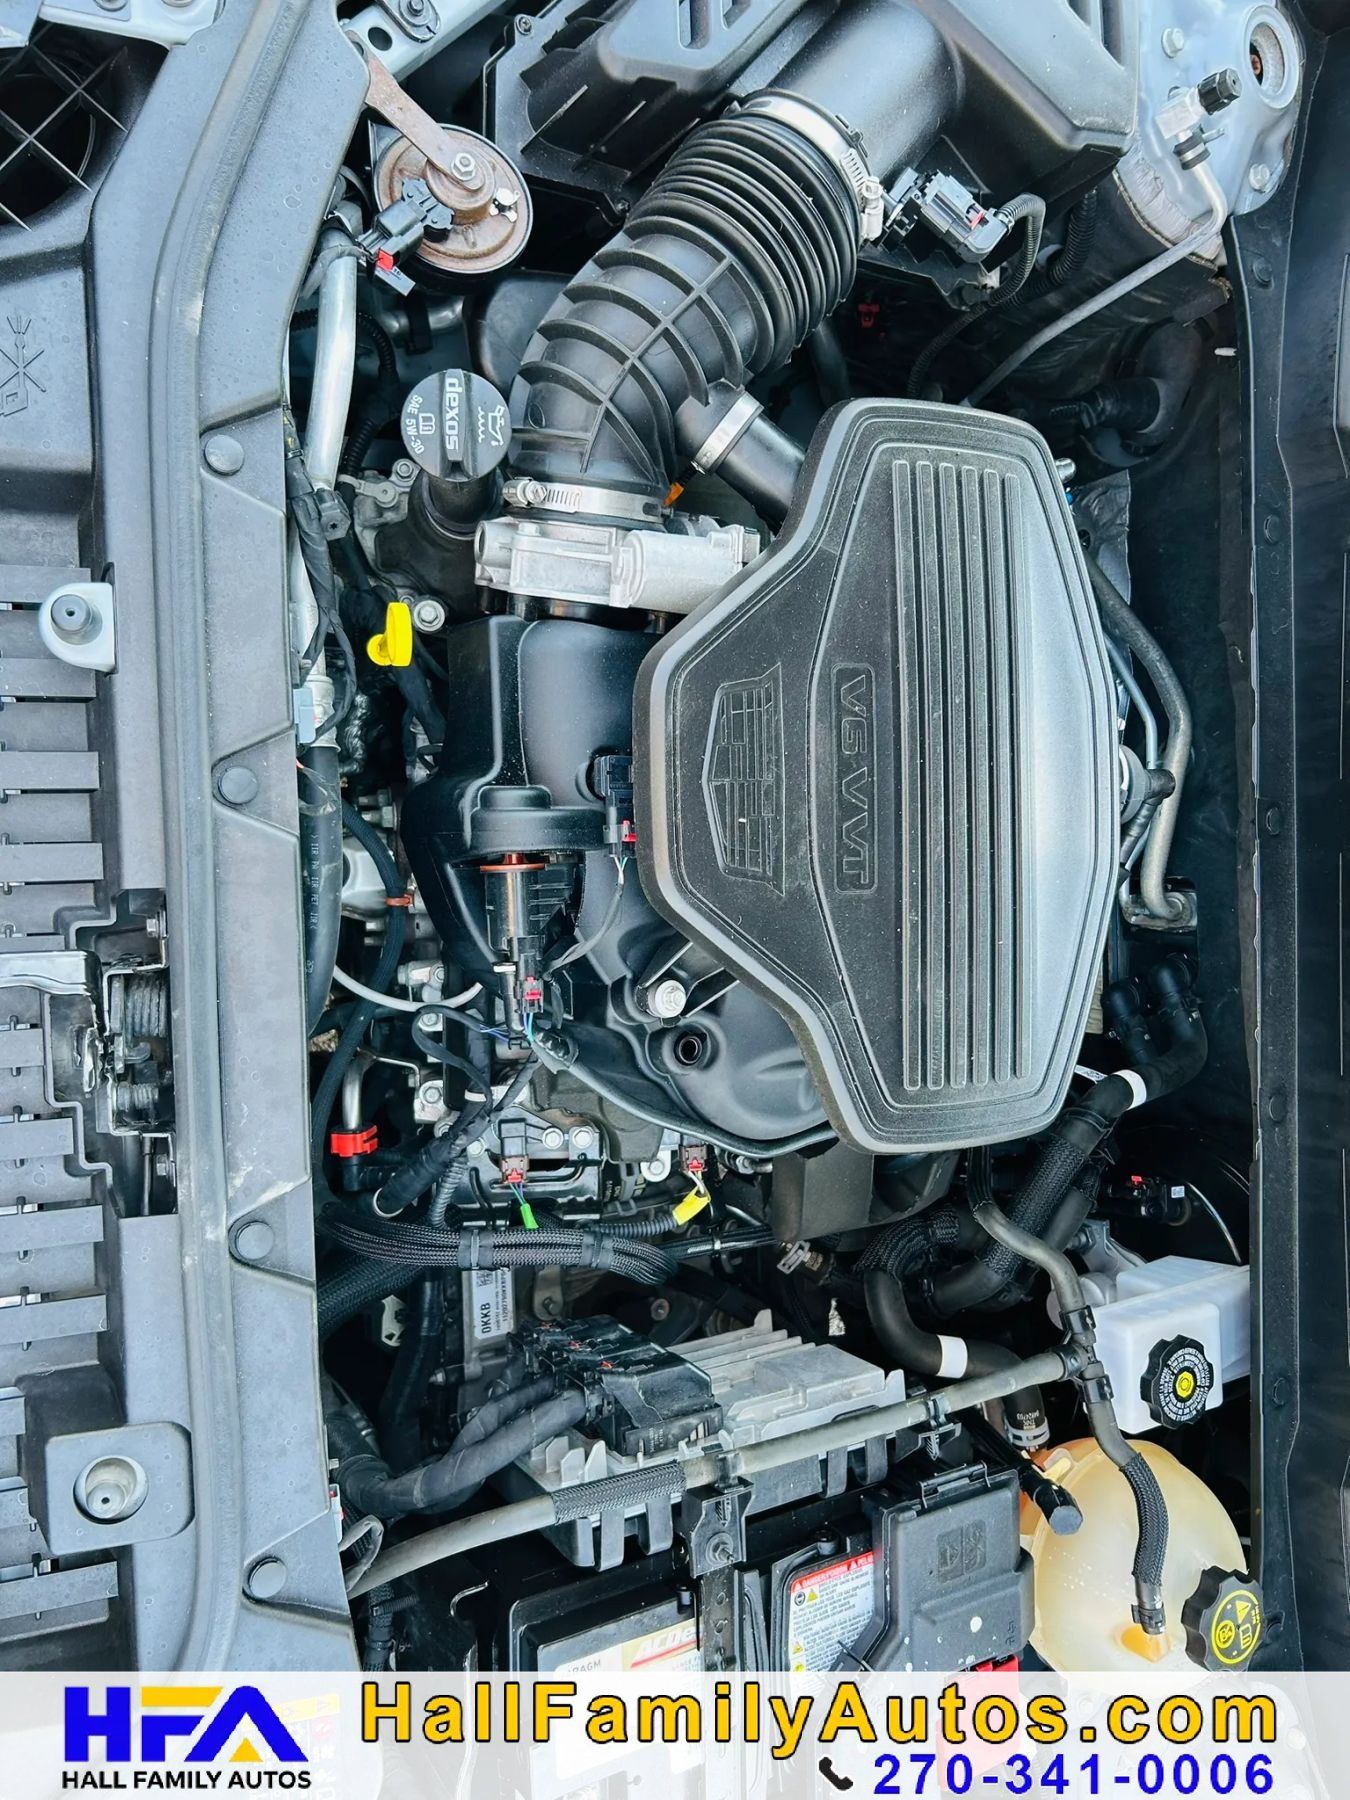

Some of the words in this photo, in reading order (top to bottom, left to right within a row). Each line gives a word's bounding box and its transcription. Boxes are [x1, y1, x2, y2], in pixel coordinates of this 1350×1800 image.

[405, 418, 425, 455] 5W-30
[407, 394, 423, 415] SAE
[445, 377, 463, 453] dexos
[840, 674, 868, 755] V6
[842, 766, 870, 885] VVT
